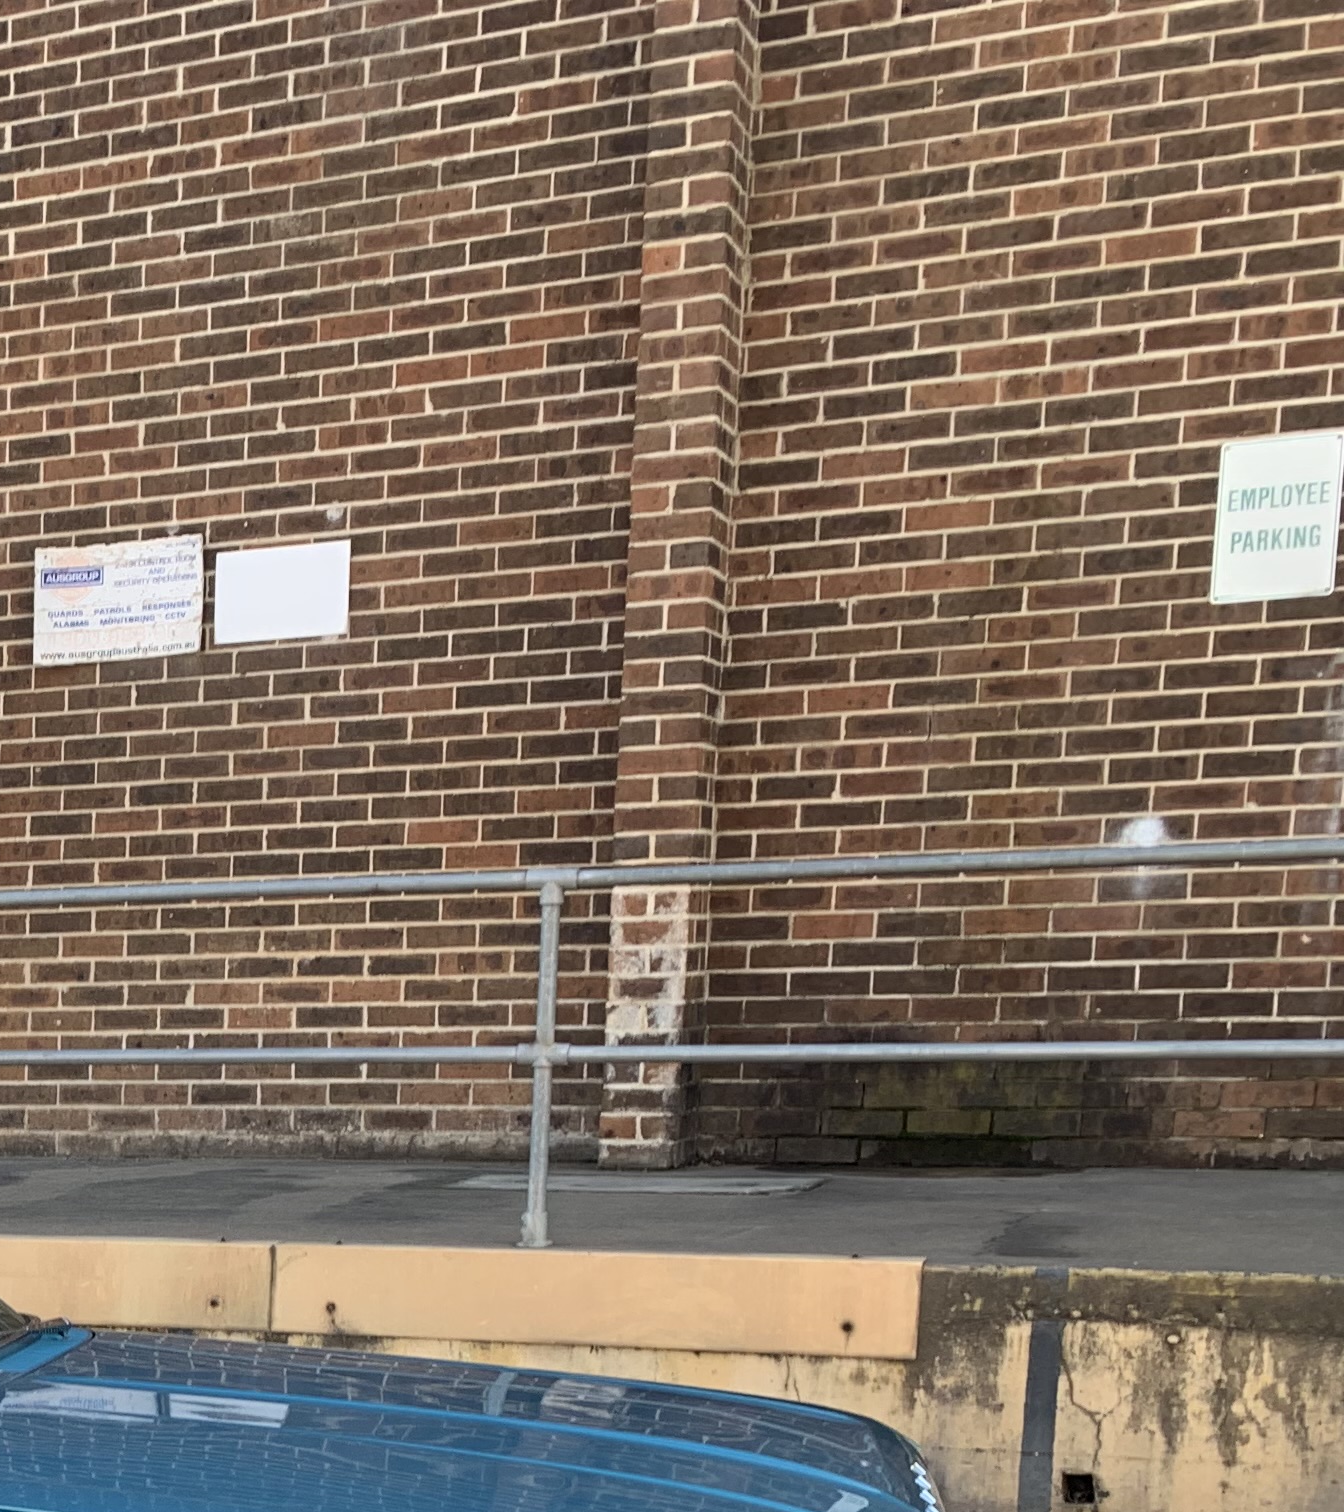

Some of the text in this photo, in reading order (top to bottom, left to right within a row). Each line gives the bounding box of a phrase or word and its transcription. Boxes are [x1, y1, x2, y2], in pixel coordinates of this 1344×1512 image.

[1227, 480, 1331, 512] EMPLOYEE
[1230, 524, 1322, 554] PARKING
[45, 572, 100, 584] AUSGROUP
[148, 567, 166, 575] AND
[48, 600, 192, 619] GUARDS PATROLS RESPONSES
[53, 611, 187, 628] ALARMS MONITORING CCTV
